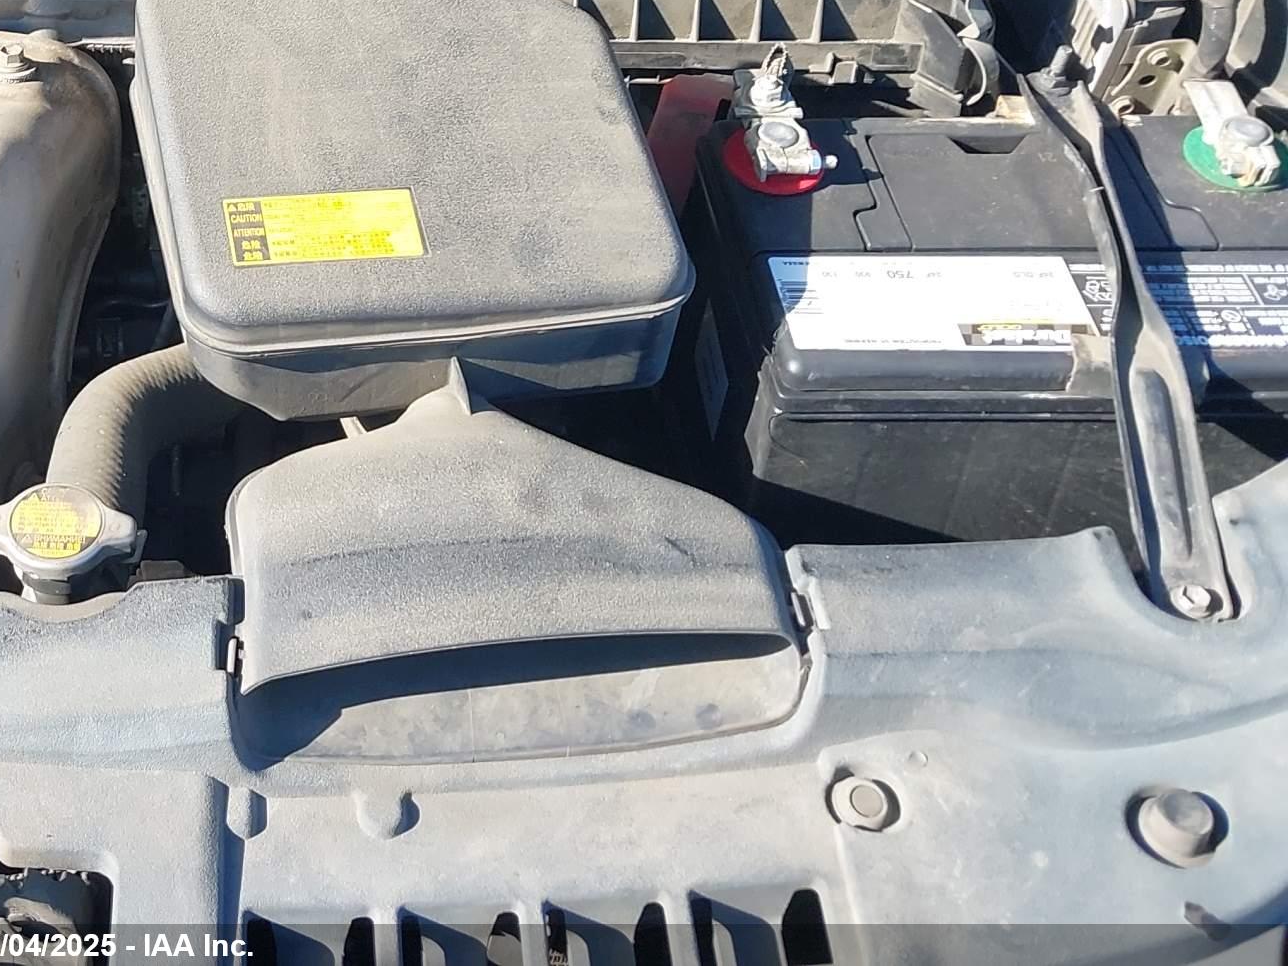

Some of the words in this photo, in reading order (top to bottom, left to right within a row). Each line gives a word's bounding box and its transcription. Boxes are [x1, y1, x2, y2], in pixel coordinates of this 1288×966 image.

[230, 212, 263, 223] CAUTION
[233, 227, 265, 238] ATTENTION
[886, 270, 914, 280] 750
